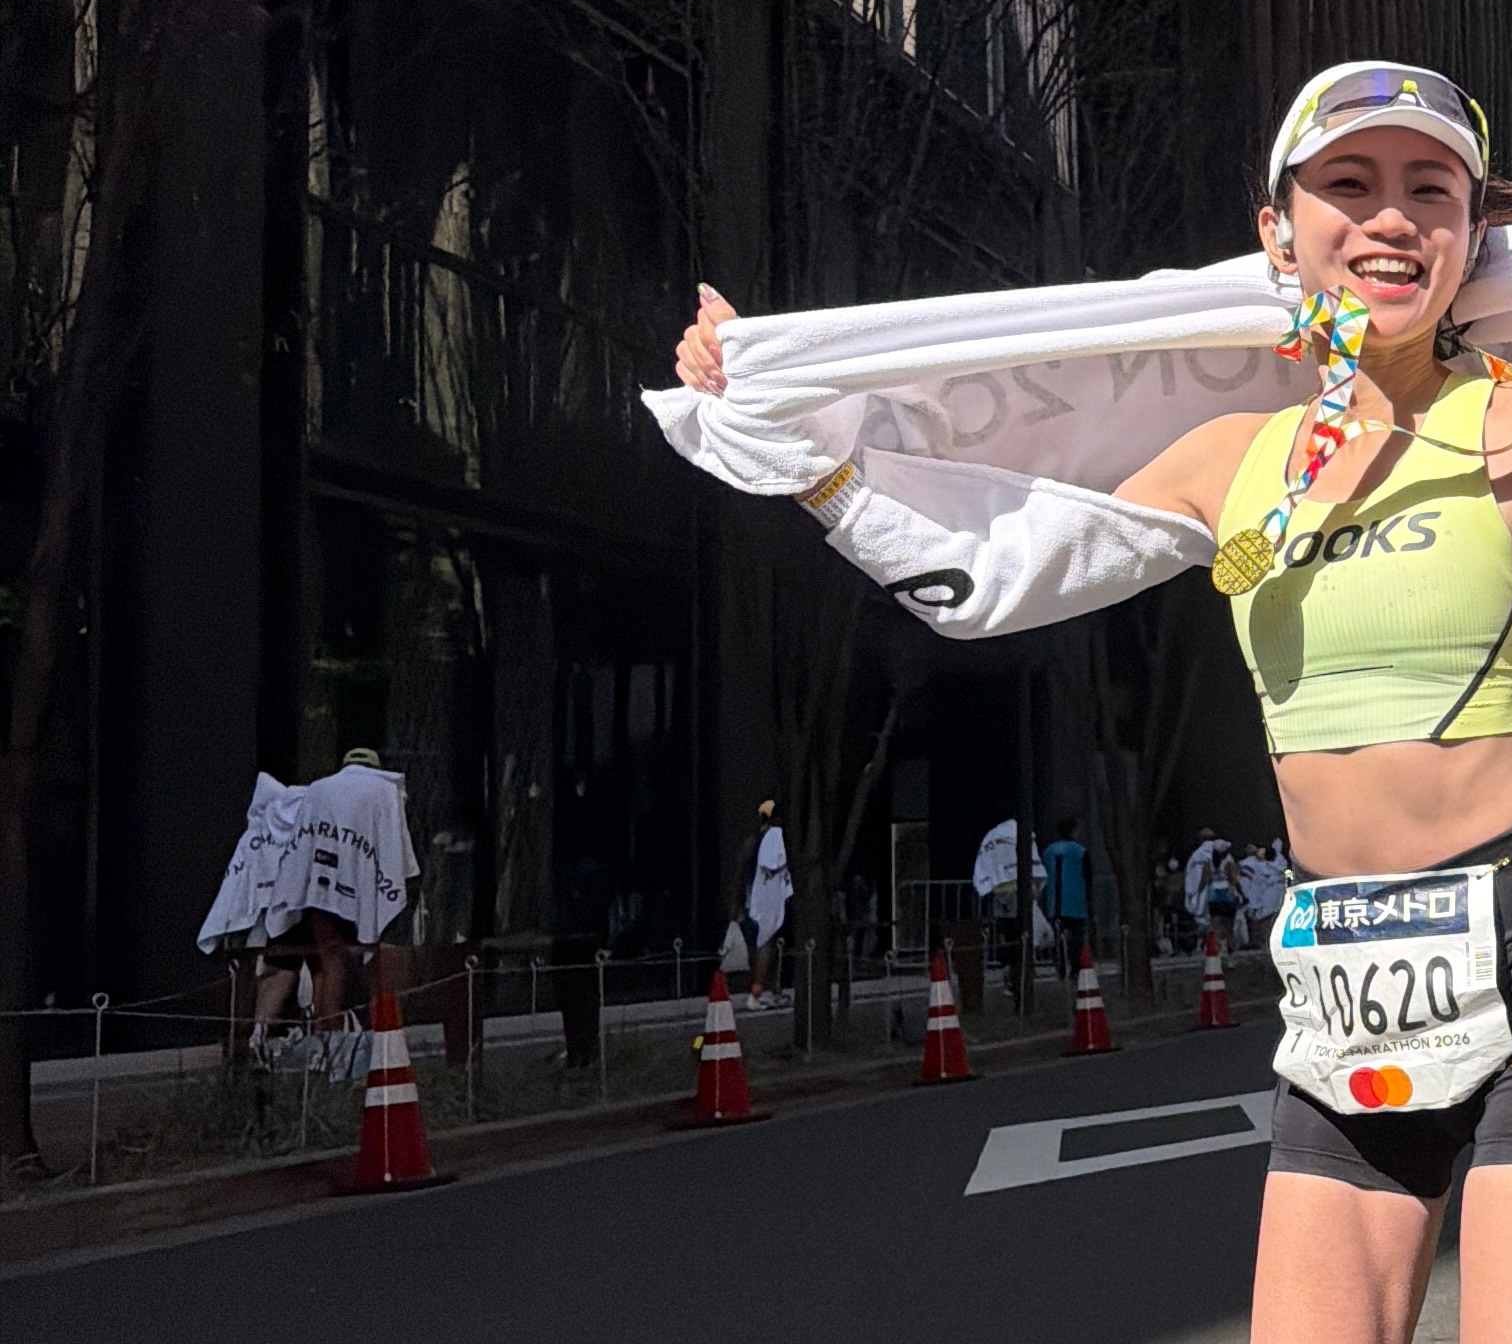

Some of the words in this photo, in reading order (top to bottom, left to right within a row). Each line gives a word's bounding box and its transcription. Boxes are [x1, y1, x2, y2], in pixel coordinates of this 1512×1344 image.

[1283, 511, 1442, 568] OOKS
[1320, 891, 1456, 930] 東京メトロ
[1286, 972, 1308, 1008] C
[1312, 955, 1461, 1037] 10620
[1349, 1036, 1431, 1057] MARATHON
[1434, 1033, 1471, 1048] 2026
